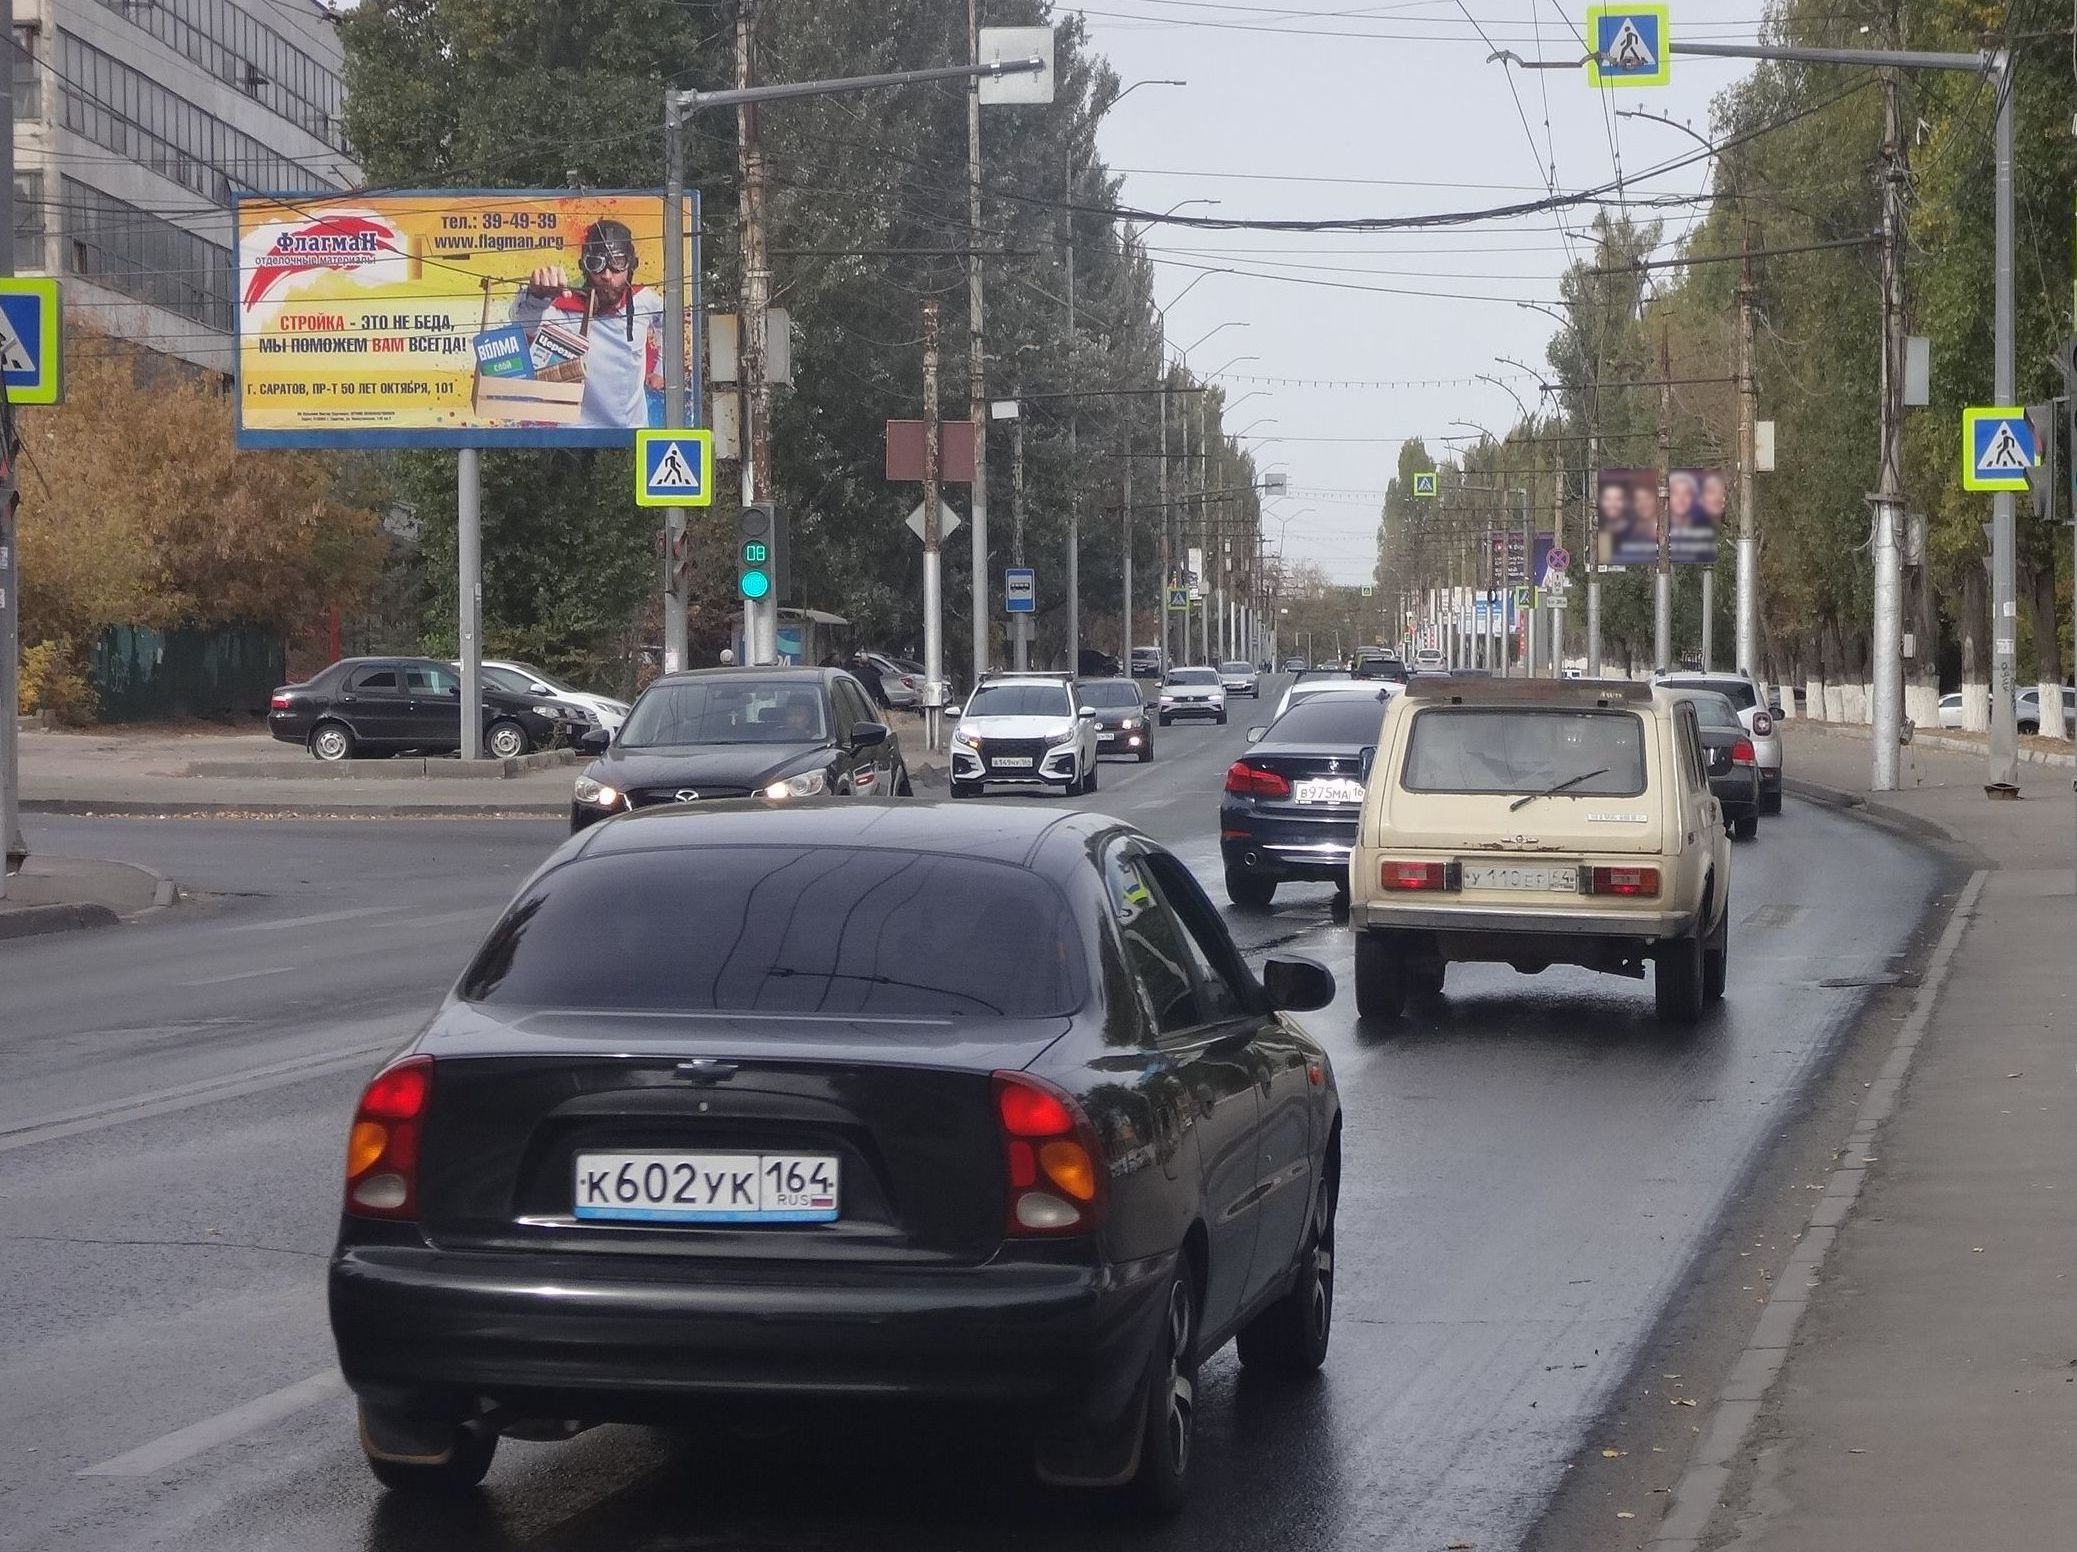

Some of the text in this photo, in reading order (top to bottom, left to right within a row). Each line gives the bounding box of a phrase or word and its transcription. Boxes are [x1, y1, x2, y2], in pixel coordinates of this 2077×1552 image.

[441, 213, 557, 230] тел.: 39-49-39
[434, 233, 564, 251] www.flagman.org
[255, 254, 377, 267] отделочные материалы
[280, 312, 345, 331] СТРОЙКА
[361, 314, 389, 331] ЭТО
[393, 314, 410, 331] НЕ
[414, 314, 455, 333] БЕДА,
[259, 336, 467, 354] МЫ ПОМОЖЕМ ВАМ ВСЕГДА!
[247, 382, 454, 396] Г. САРАТОВ, ПР-Т 50 ЛЕТ ОКТЯБРЯ, 101
[746, 545, 766, 561] 08
[1300, 786, 1349, 800] В975МА
[585, 1160, 829, 1205] К602УК 164
[776, 1193, 810, 1207] RUS
